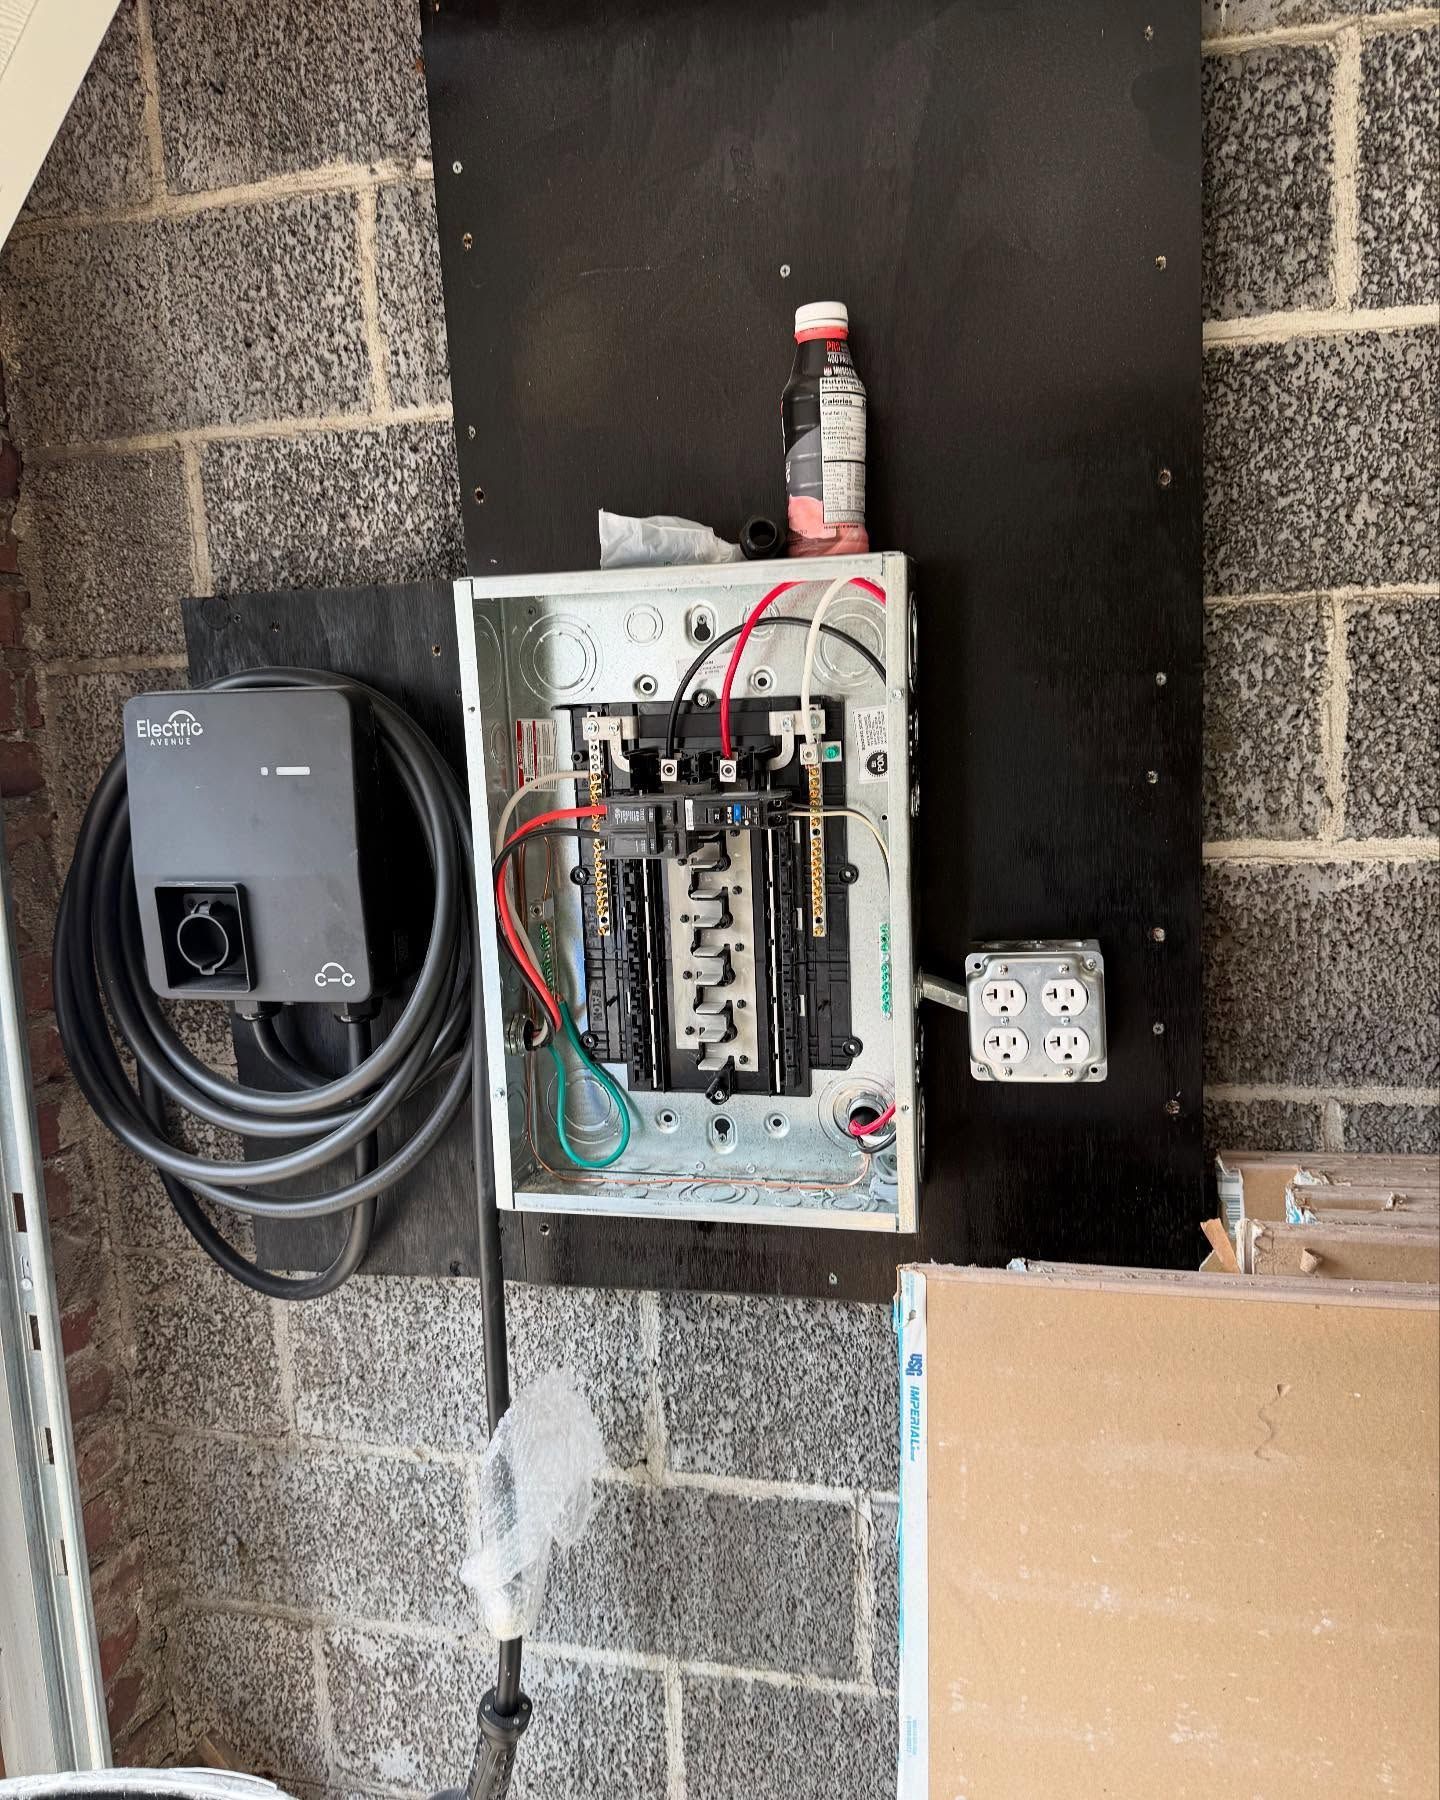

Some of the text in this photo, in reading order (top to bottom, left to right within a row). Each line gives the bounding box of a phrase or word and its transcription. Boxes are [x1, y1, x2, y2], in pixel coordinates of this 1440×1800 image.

[821, 398, 853, 407] Calories
[136, 717, 203, 738] Electric
[150, 737, 191, 746] AVENUE
[905, 1353, 923, 1377] USG
[910, 1385, 921, 1446] IMPERIAL
